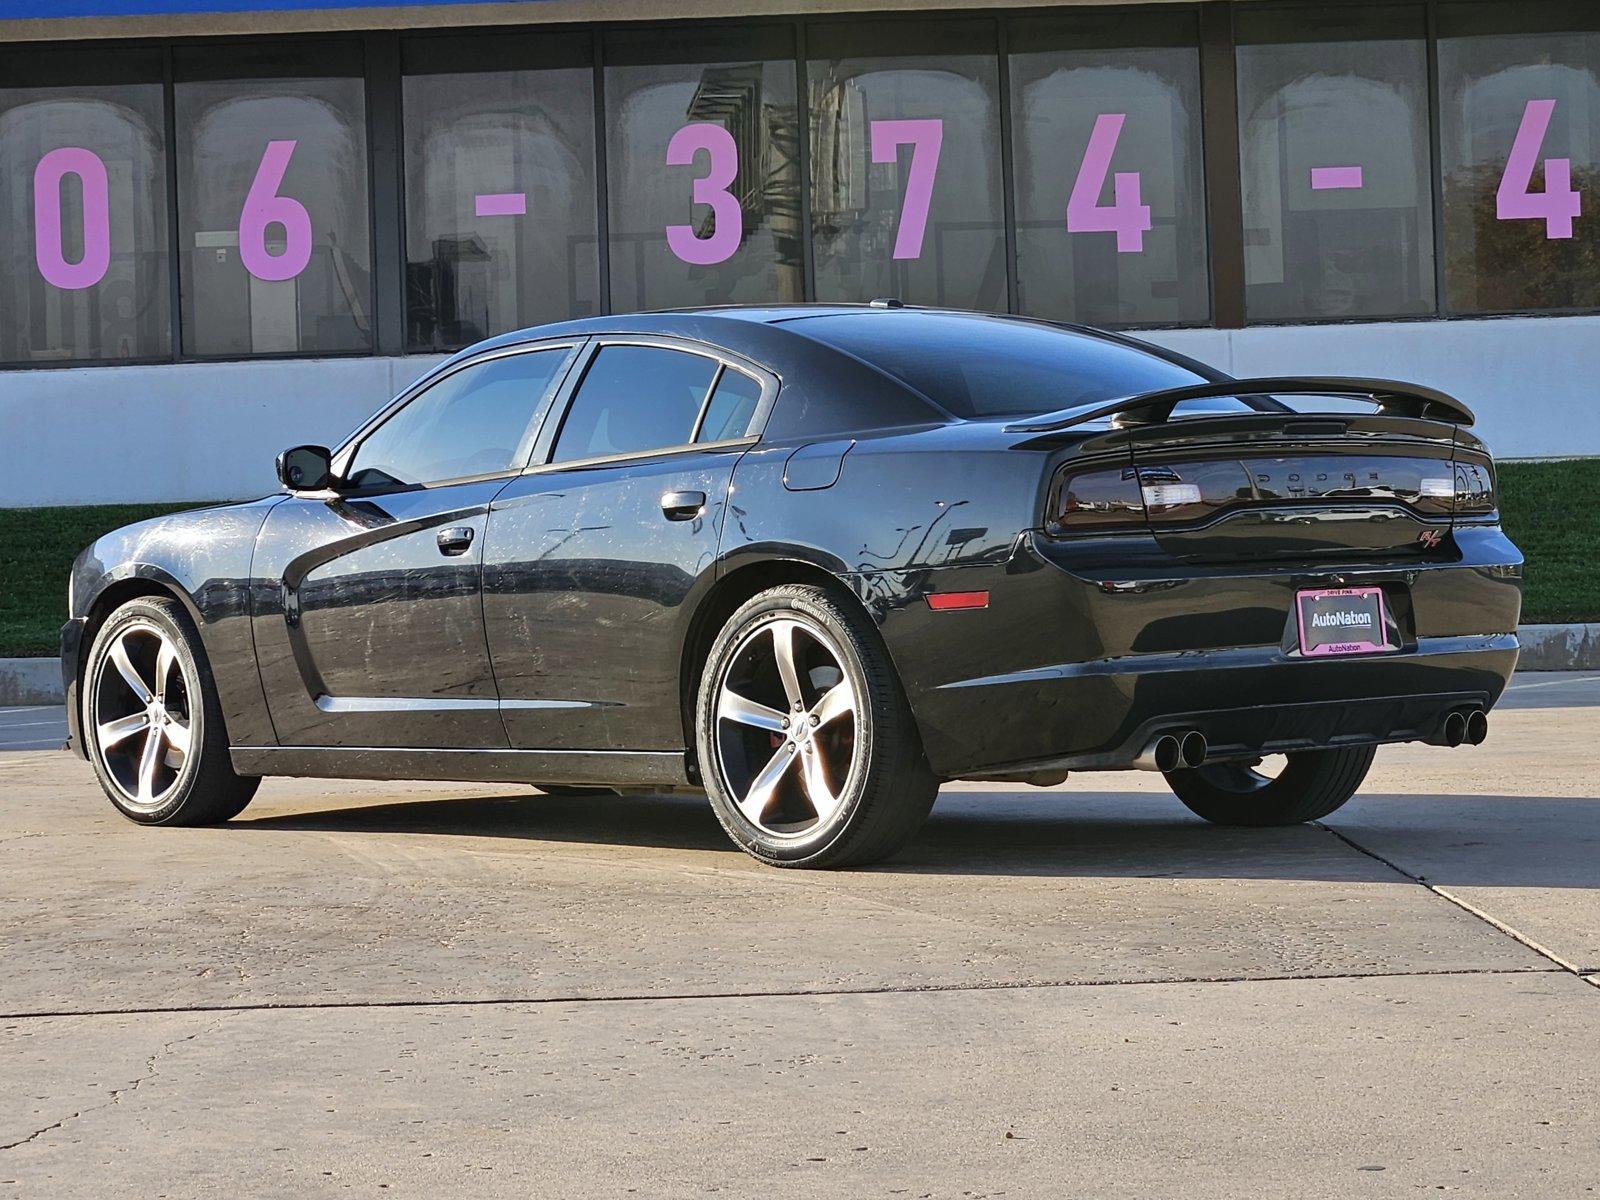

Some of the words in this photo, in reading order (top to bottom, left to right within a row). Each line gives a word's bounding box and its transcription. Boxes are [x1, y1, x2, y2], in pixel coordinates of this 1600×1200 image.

[1257, 472, 1379, 483] DODGE
[1419, 530, 1441, 549] R/T
[1312, 611, 1371, 627] AutoNation
[1328, 644, 1361, 653] AutoNation
